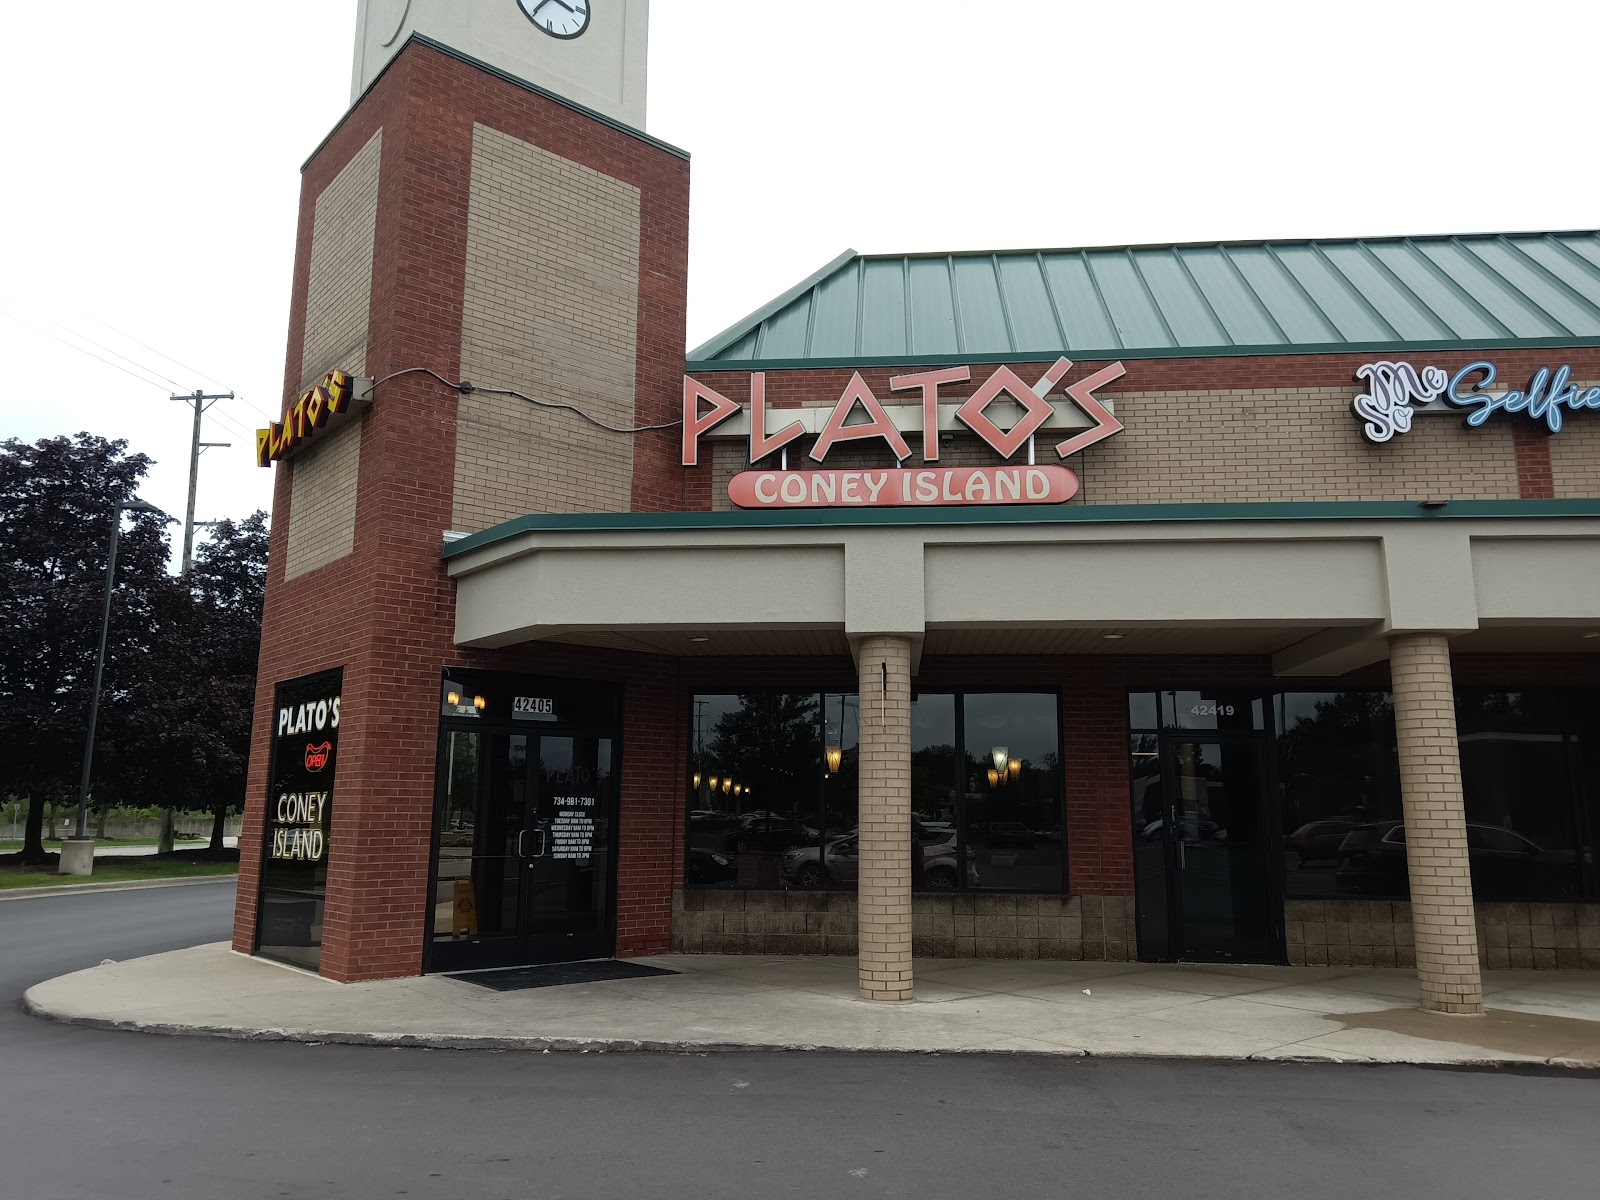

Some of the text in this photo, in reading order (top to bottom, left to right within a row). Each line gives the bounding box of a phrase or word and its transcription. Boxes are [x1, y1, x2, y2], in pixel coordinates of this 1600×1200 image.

[1355, 361, 1448, 411] Me
[256, 369, 345, 467] PLATO'S
[682, 355, 1128, 467] PLATO'S
[1353, 393, 1415, 443] So
[753, 469, 1051, 503] CONEY ISLAND
[278, 696, 341, 738] PLATO'S
[515, 697, 553, 713] 42405
[1190, 705, 1235, 716] 42419
[306, 753, 325, 767] OPEN
[277, 791, 328, 824] CONEY
[553, 796, 595, 807] 734-981-7301
[272, 828, 324, 861] ISLAND
